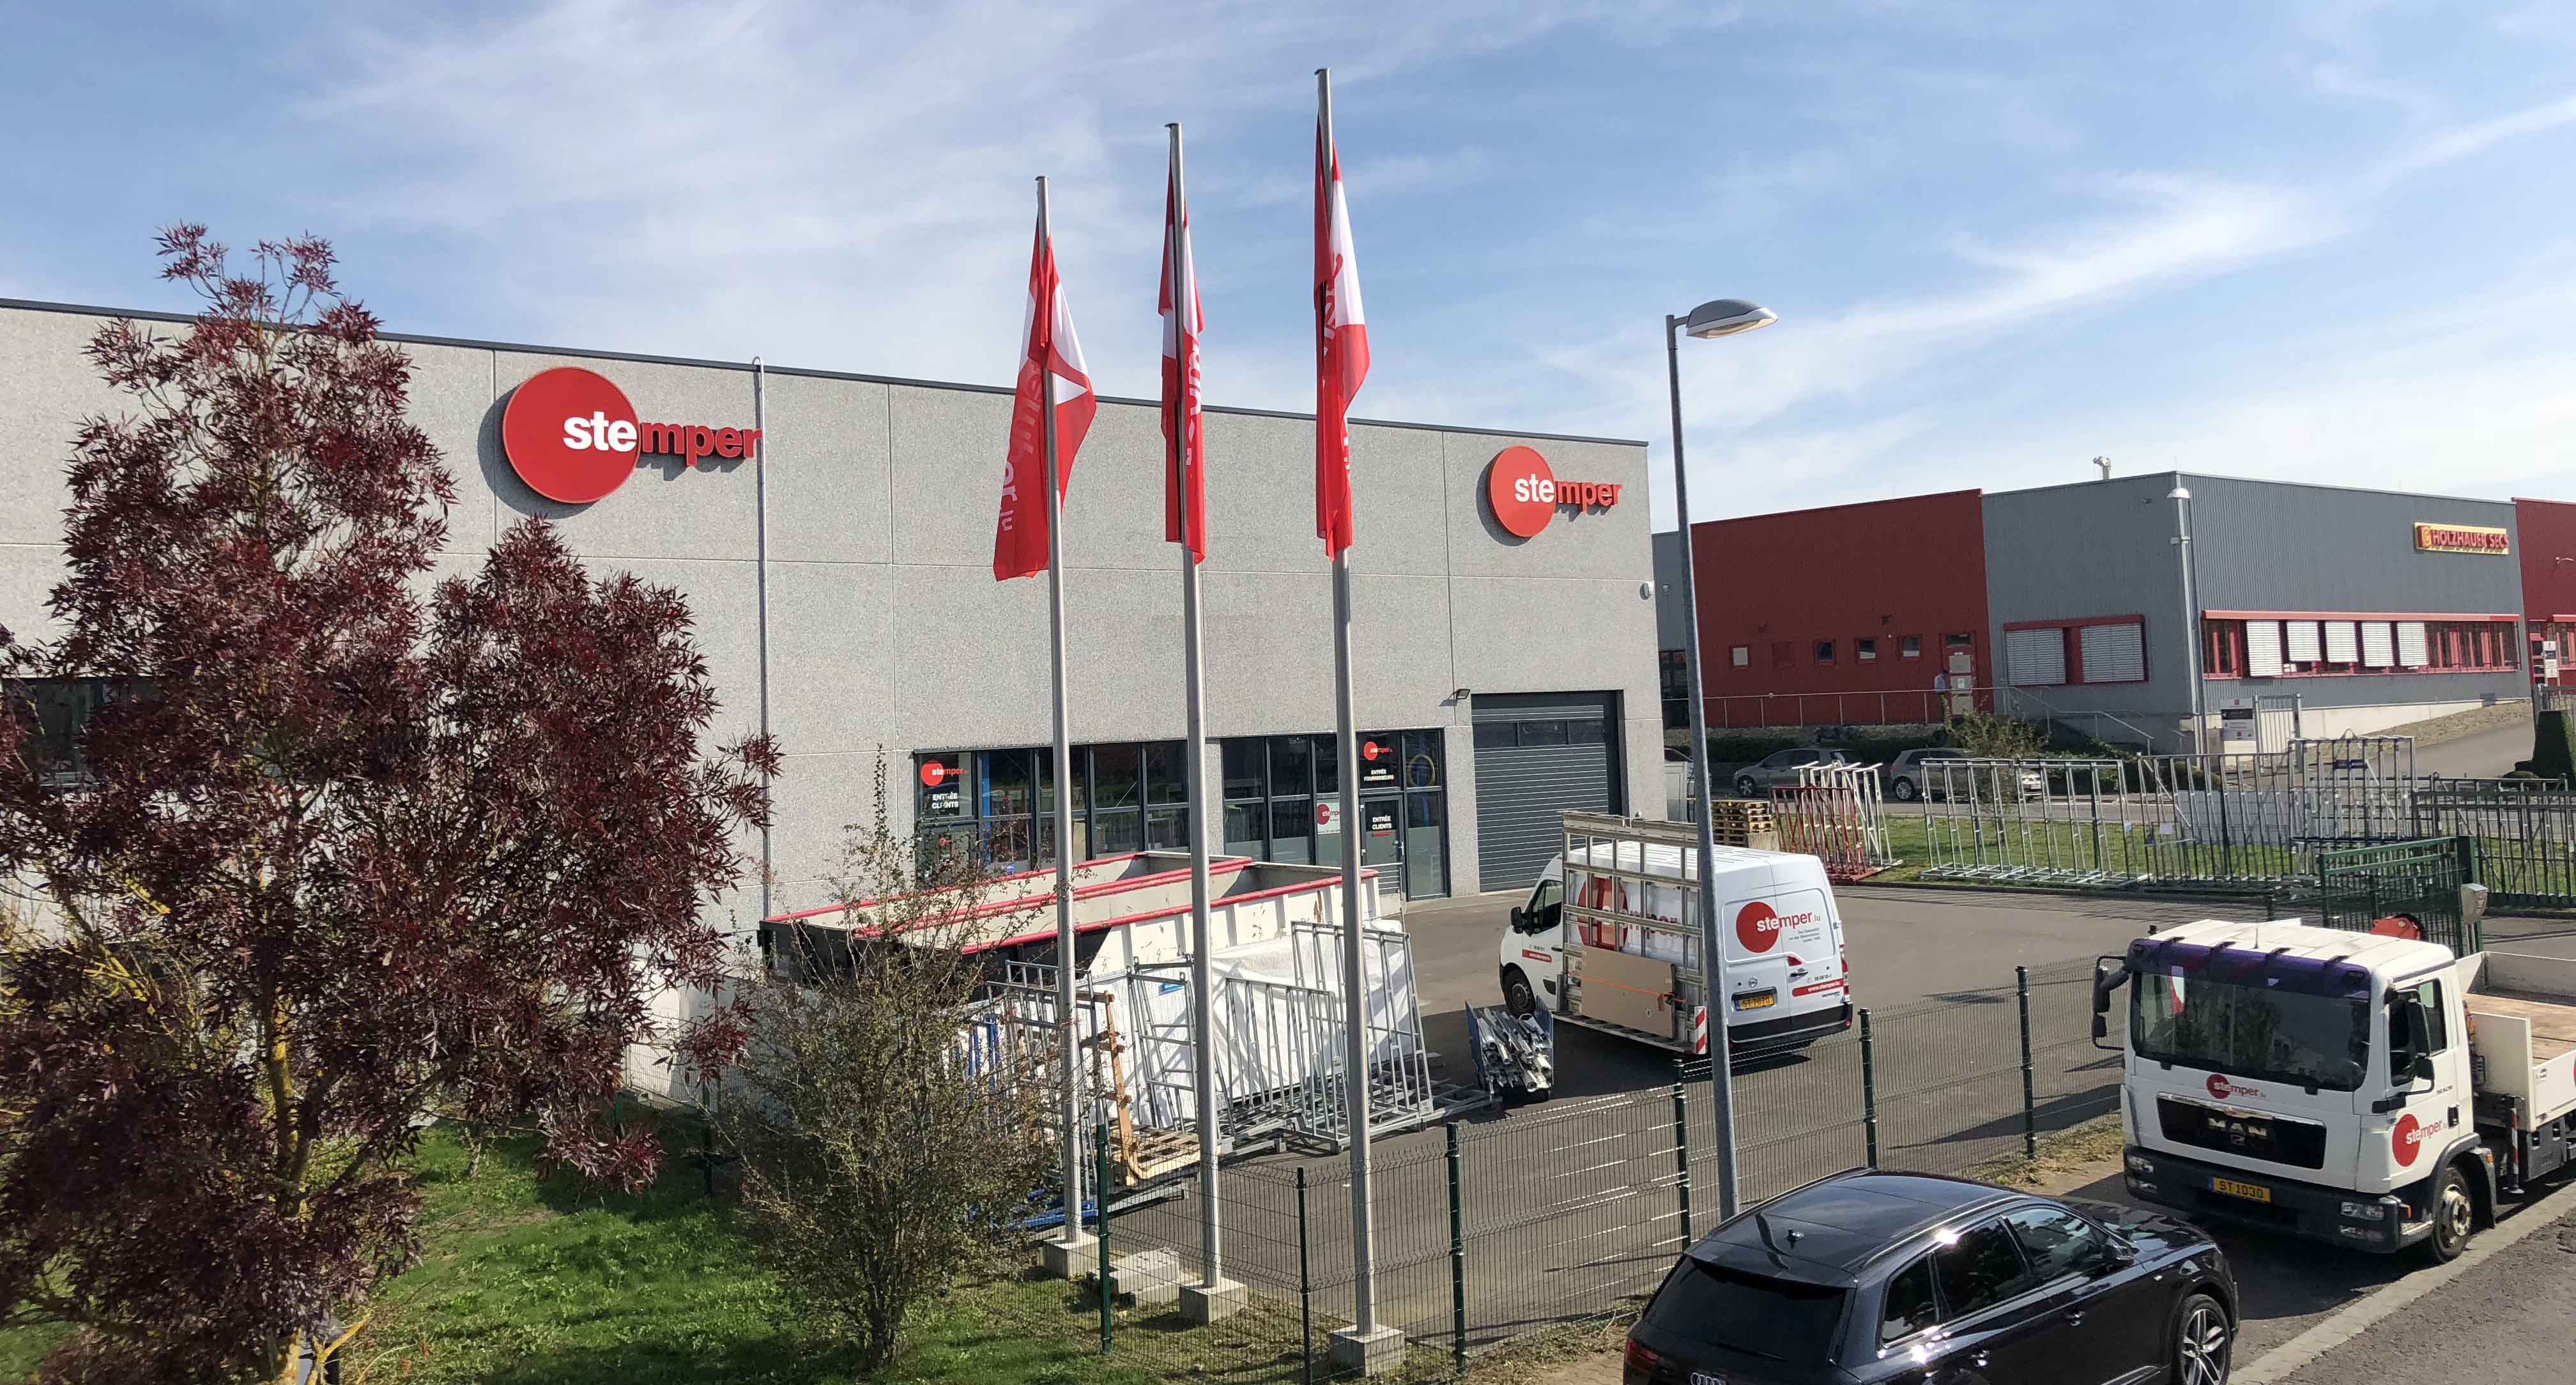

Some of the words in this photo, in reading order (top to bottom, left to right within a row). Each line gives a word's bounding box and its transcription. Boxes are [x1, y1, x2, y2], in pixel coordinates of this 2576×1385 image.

[563, 411, 762, 467] stemper
[1514, 473, 1623, 512] stemper
[1372, 815, 1391, 823] ENTRÉE
[2207, 1117, 2268, 1138] MAN
[2218, 1180, 2232, 1193] ST
